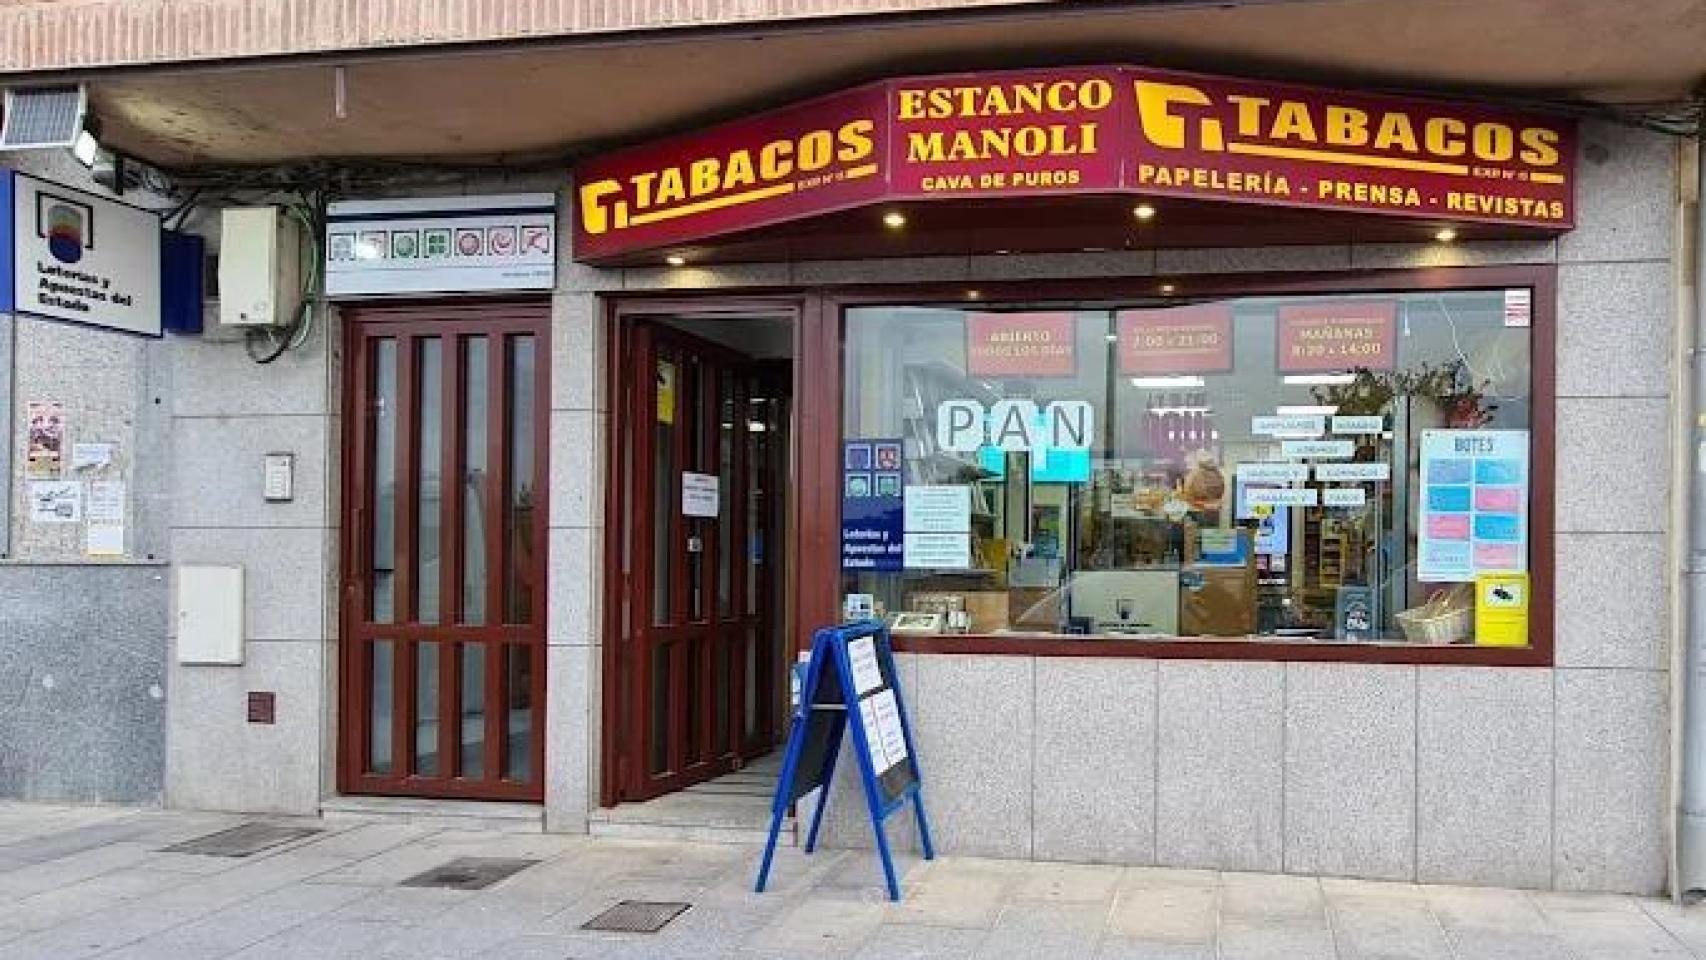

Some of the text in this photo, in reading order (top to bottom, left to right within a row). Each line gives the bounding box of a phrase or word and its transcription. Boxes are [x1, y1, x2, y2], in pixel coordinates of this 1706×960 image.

[897, 79, 1113, 120] ESTANCO
[906, 122, 1099, 163] MANOLI
[1226, 94, 1560, 167] TABACOS
[630, 119, 875, 209] TABACOS
[921, 170, 1081, 190] CAVA DE PUROS
[1138, 163, 1291, 196] PAPELERÍA
[1318, 179, 1421, 207] PRENSA
[1446, 191, 1565, 219] REVISTAS
[38, 292, 90, 312] Estado
[947, 405, 1086, 447] PAN
[1454, 437, 1494, 453] BOTES
